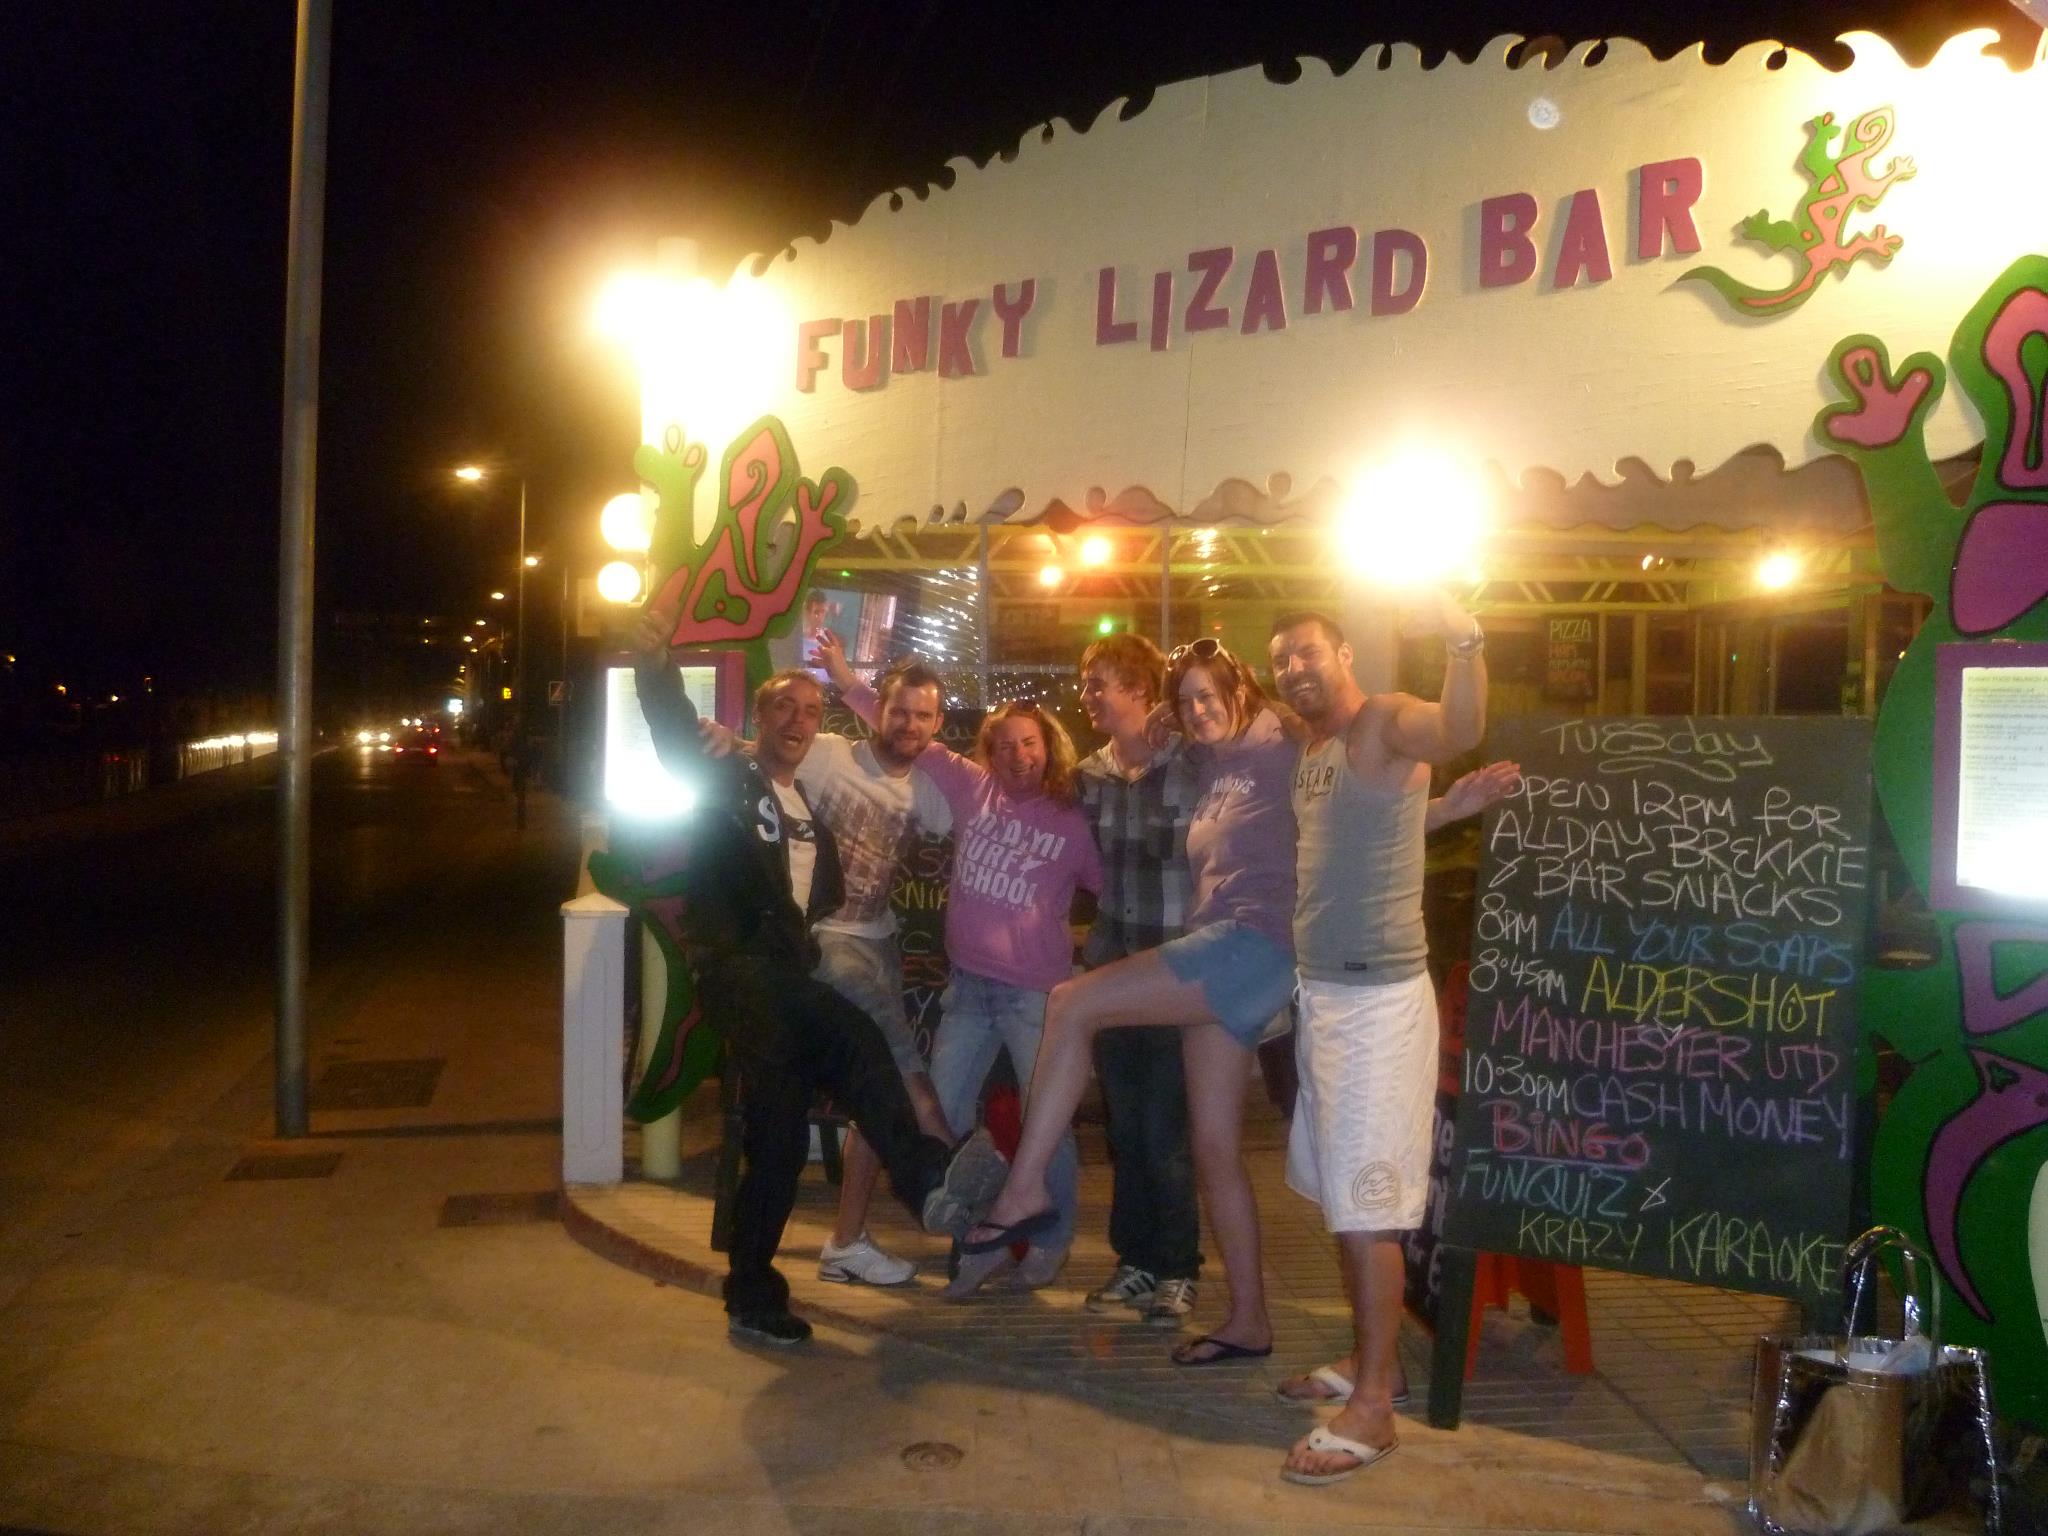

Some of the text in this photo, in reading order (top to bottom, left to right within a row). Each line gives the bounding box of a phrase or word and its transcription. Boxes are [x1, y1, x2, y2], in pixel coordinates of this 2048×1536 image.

[796, 156, 1704, 393] FUNKY LIZARD BAR
[1551, 619, 1592, 640] PIZZA
[1632, 779, 1736, 827] 12PM
[1533, 855, 1634, 908] BAR
[1641, 870, 1843, 928] SNACKS
[1549, 901, 1615, 955] ALL
[1628, 913, 1715, 964] YOUR
[1580, 957, 1837, 1036] ALDERSHOT
[1765, 1042, 1840, 1095] UTD
[1571, 1073, 1688, 1131] CASH
[1699, 1081, 1852, 1160] MONEY
[1517, 1208, 1849, 1296] KRAZY KARAOKE
